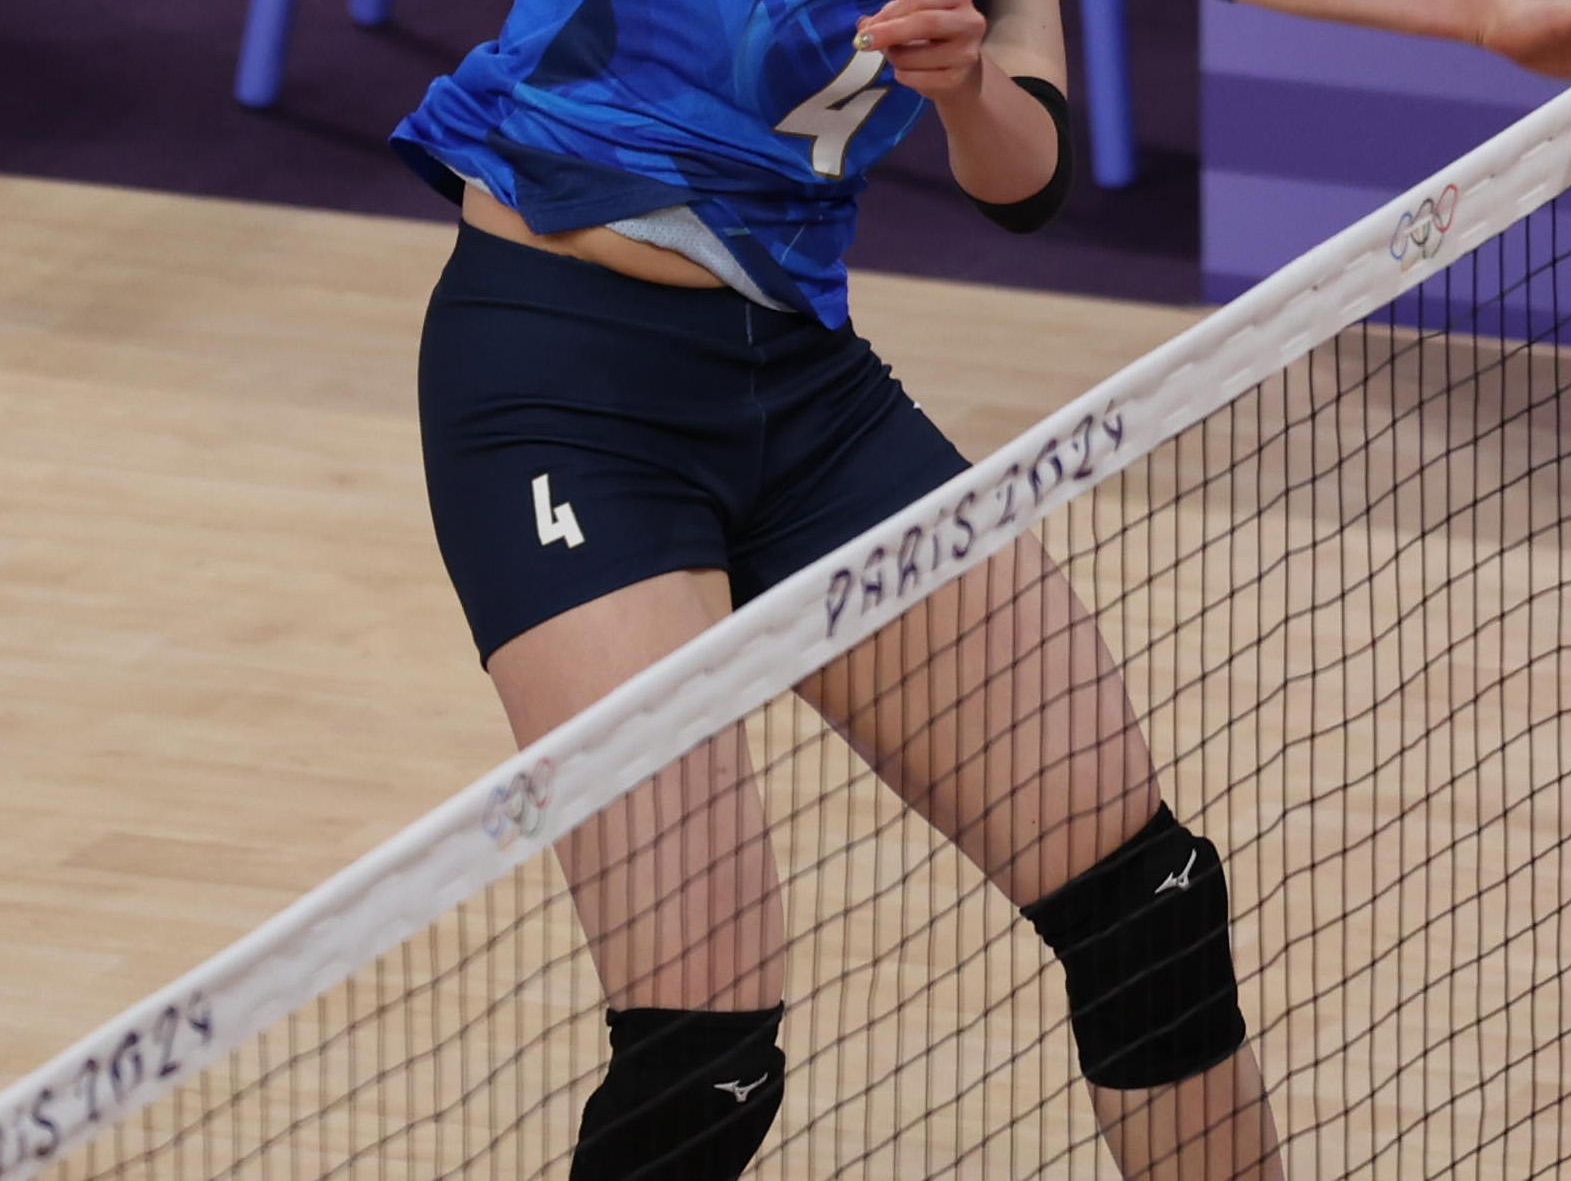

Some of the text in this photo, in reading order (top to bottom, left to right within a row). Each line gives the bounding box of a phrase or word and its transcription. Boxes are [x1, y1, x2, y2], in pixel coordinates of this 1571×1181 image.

[773, 50, 889, 179] 4
[531, 473, 585, 548] 4
[996, 399, 1123, 529] 2024
[74, 991, 212, 1120] 2024
